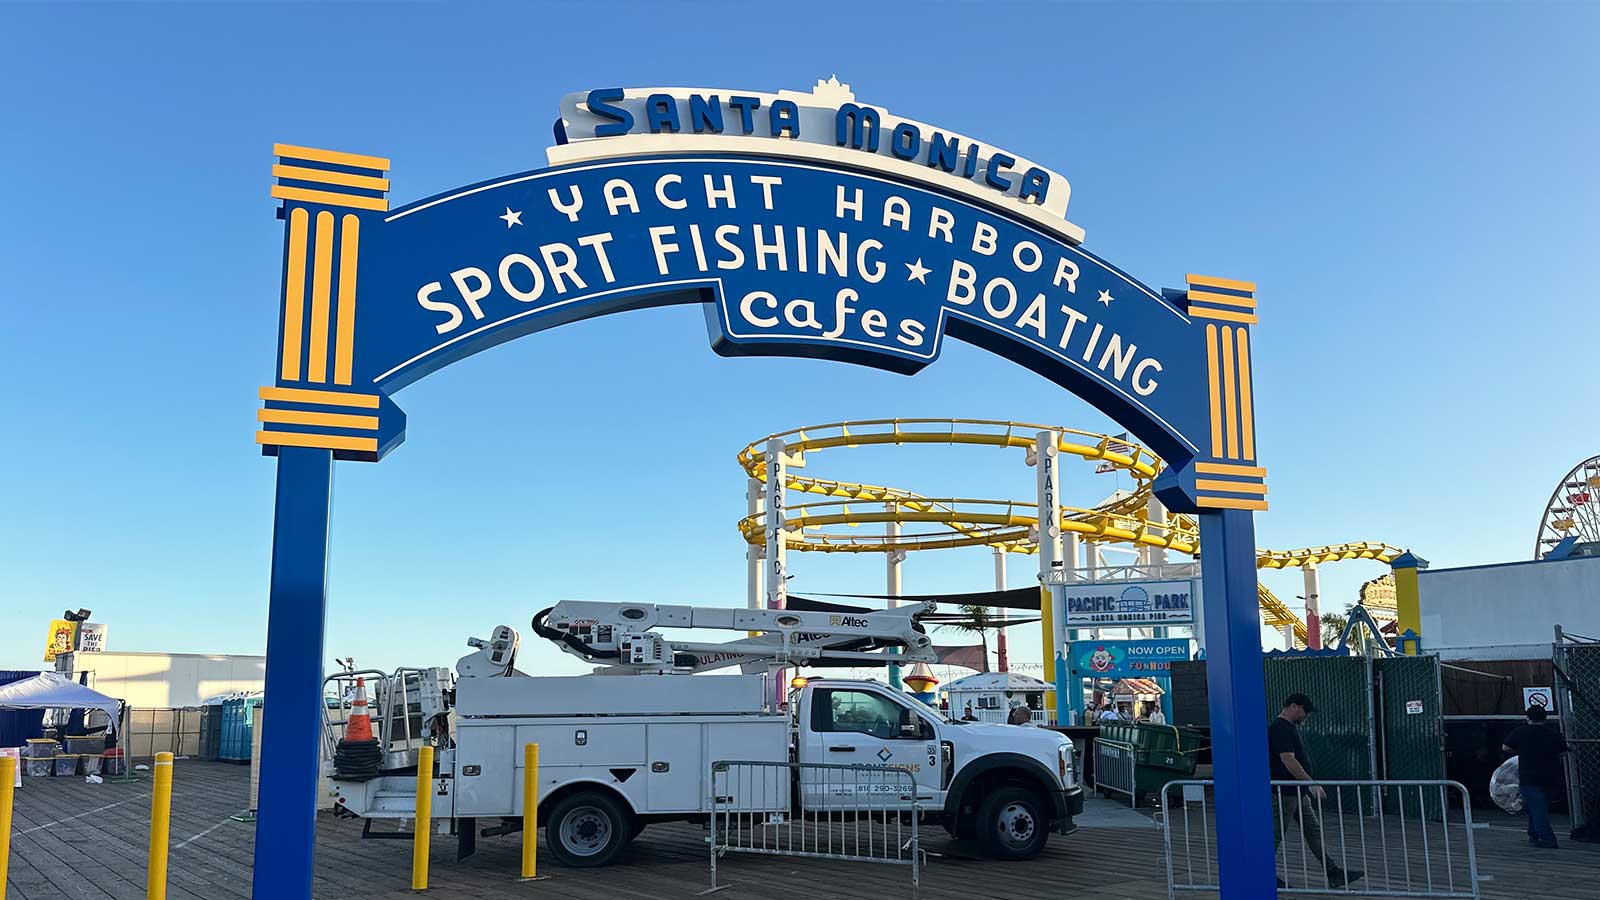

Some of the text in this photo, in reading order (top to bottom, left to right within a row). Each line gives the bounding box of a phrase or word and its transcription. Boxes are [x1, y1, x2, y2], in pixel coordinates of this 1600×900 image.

[587, 88, 1050, 205] SANTA MONICA
[548, 174, 1080, 293] YACHT HARBOR
[417, 225, 1163, 396] SPORT FISHING BOATING
[1045, 458, 1053, 526] PARK
[1068, 593, 1189, 612] PACIFIC PARK
[841, 616, 868, 627] Altec
[1117, 613, 1146, 621] MONICA
[1149, 612, 1167, 620] PIER
[84, 633, 102, 641] SAVE
[1128, 646, 1185, 655] NOW OPEN
[929, 756, 936, 766] 3
